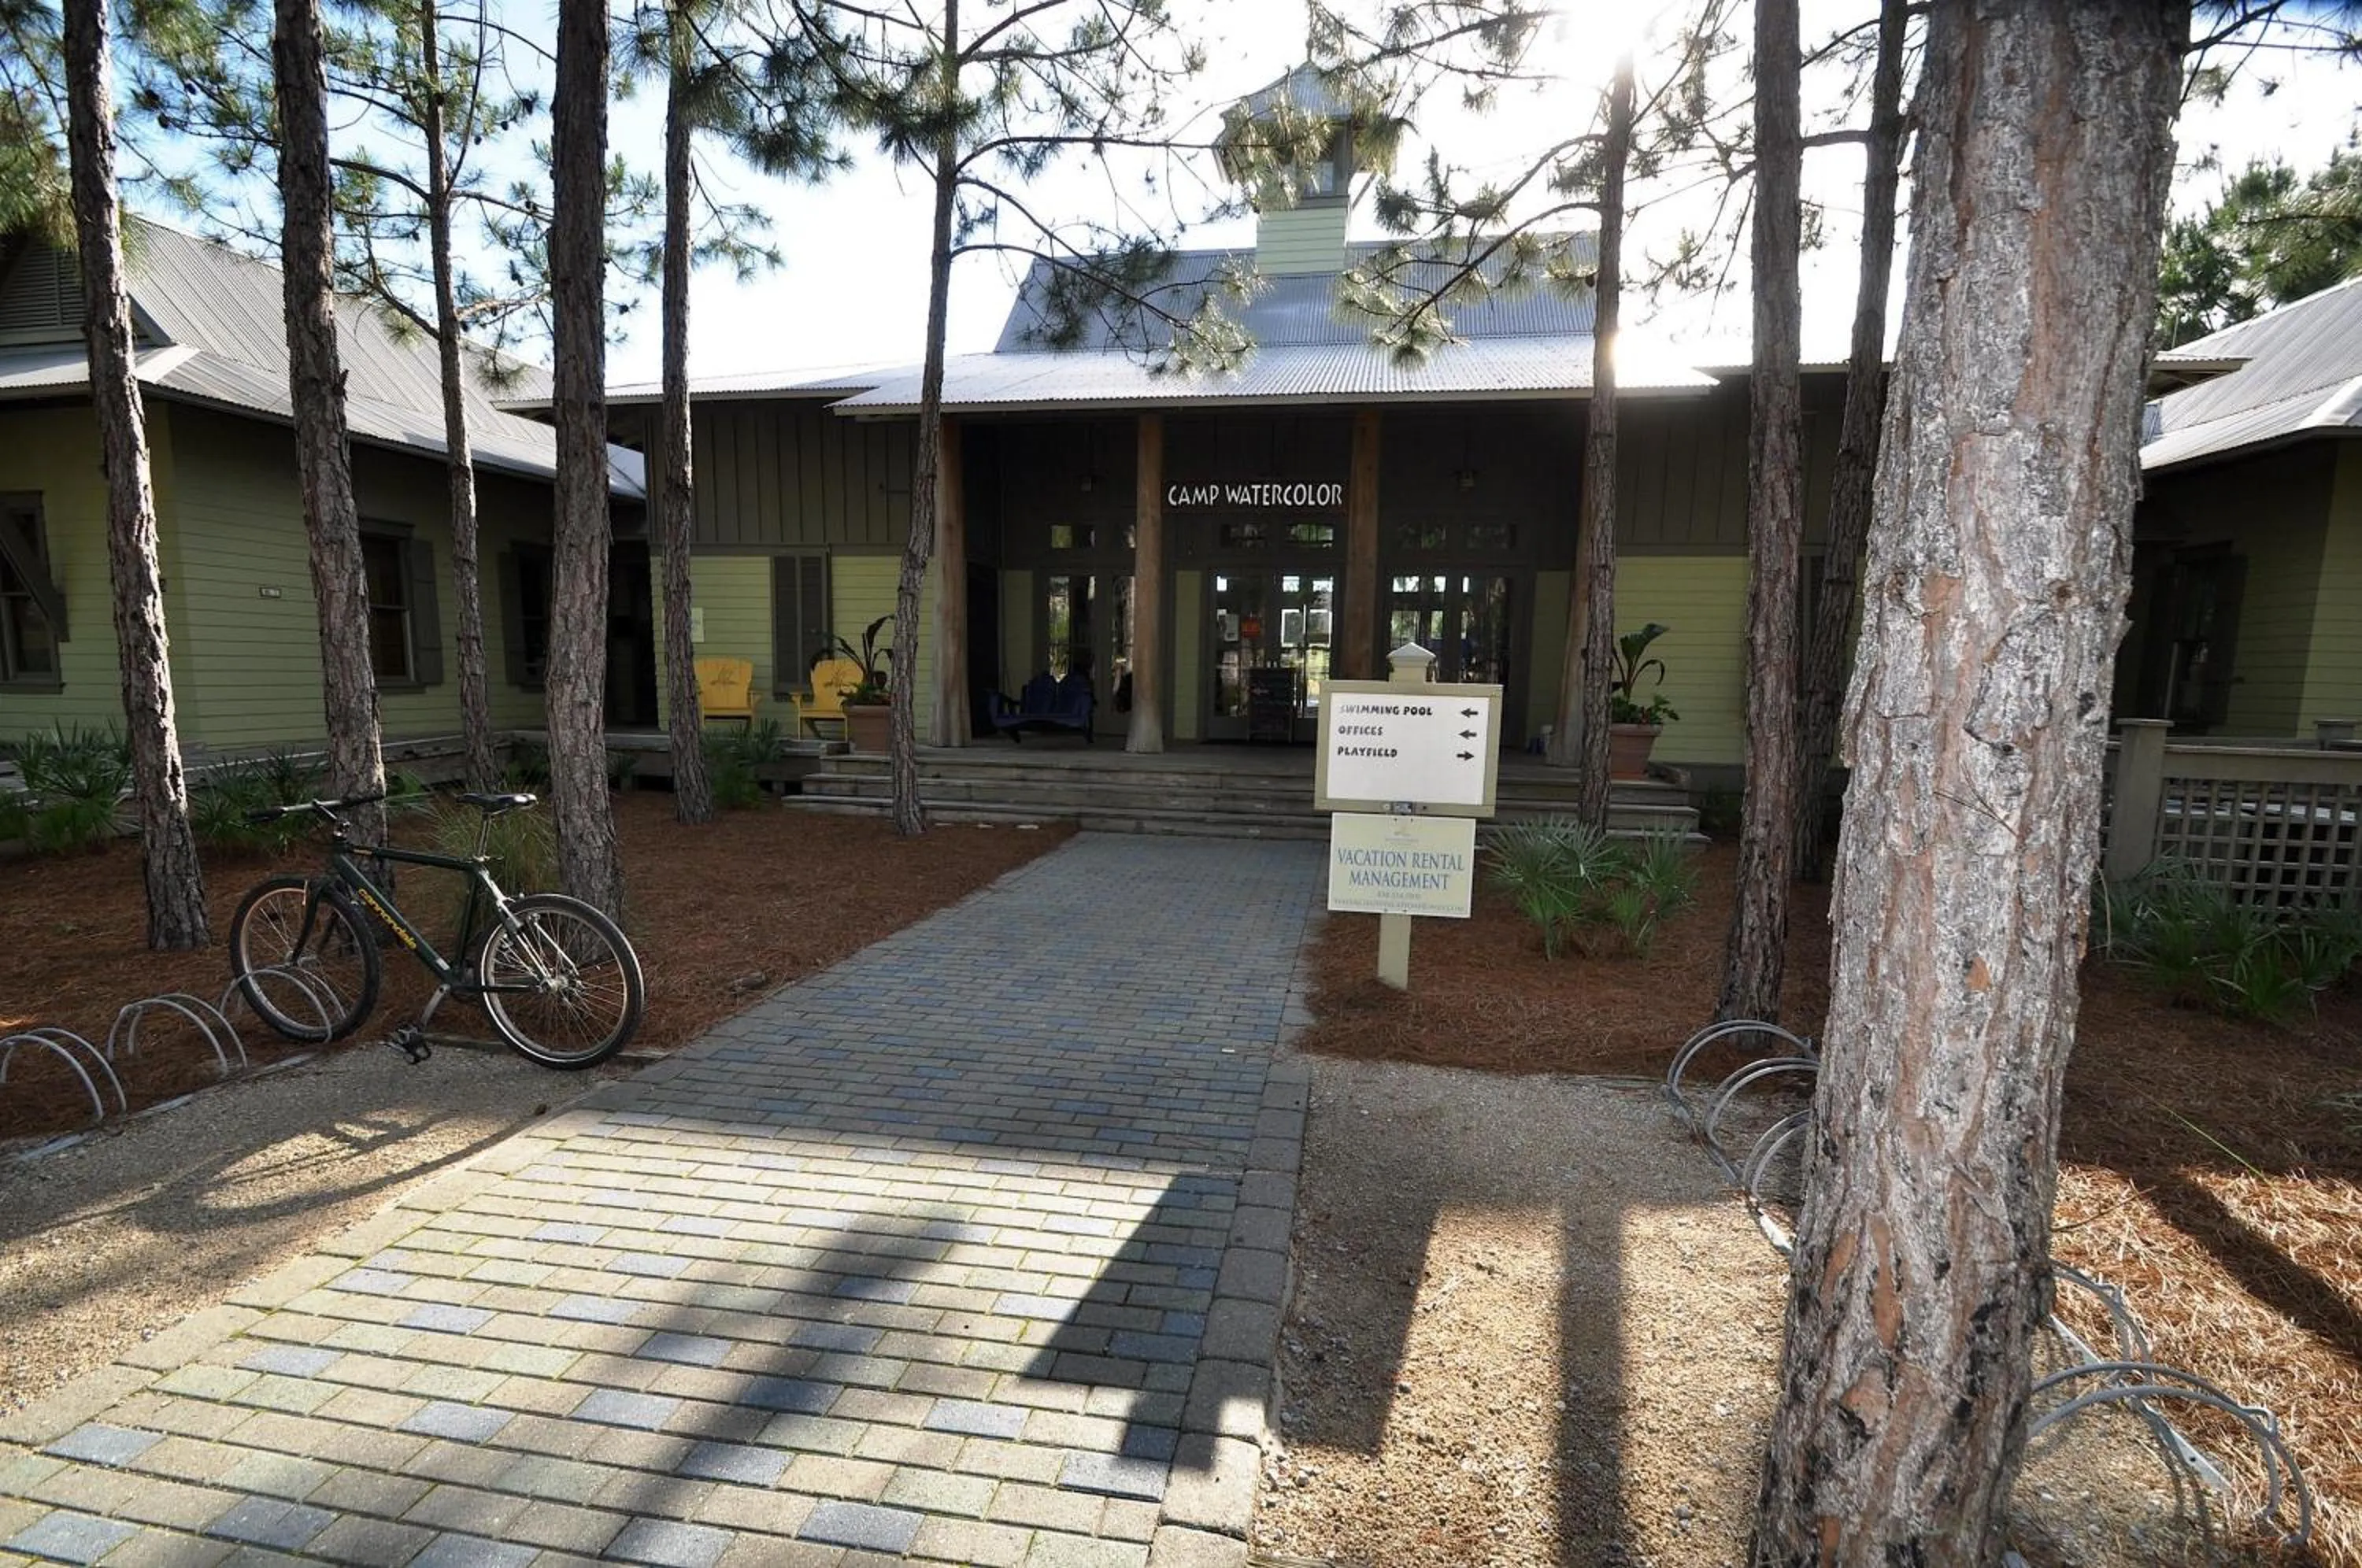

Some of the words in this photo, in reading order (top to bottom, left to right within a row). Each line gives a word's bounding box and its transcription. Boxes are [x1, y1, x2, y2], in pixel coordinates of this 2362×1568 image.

[1168, 484, 1220, 506] CAMP
[1225, 483, 1343, 506] WATERCOLOR
[1338, 704, 1400, 716] SWIMMING
[1403, 705, 1433, 716] POOL
[1338, 725, 1383, 736] OFFICES
[1337, 745, 1398, 758] PLAYFIELD
[1338, 848, 1407, 868] VACATION
[1412, 852, 1465, 871] RENTAL
[1349, 869, 1451, 890] MANAGEMENT
[358, 889, 417, 949] cannondale
